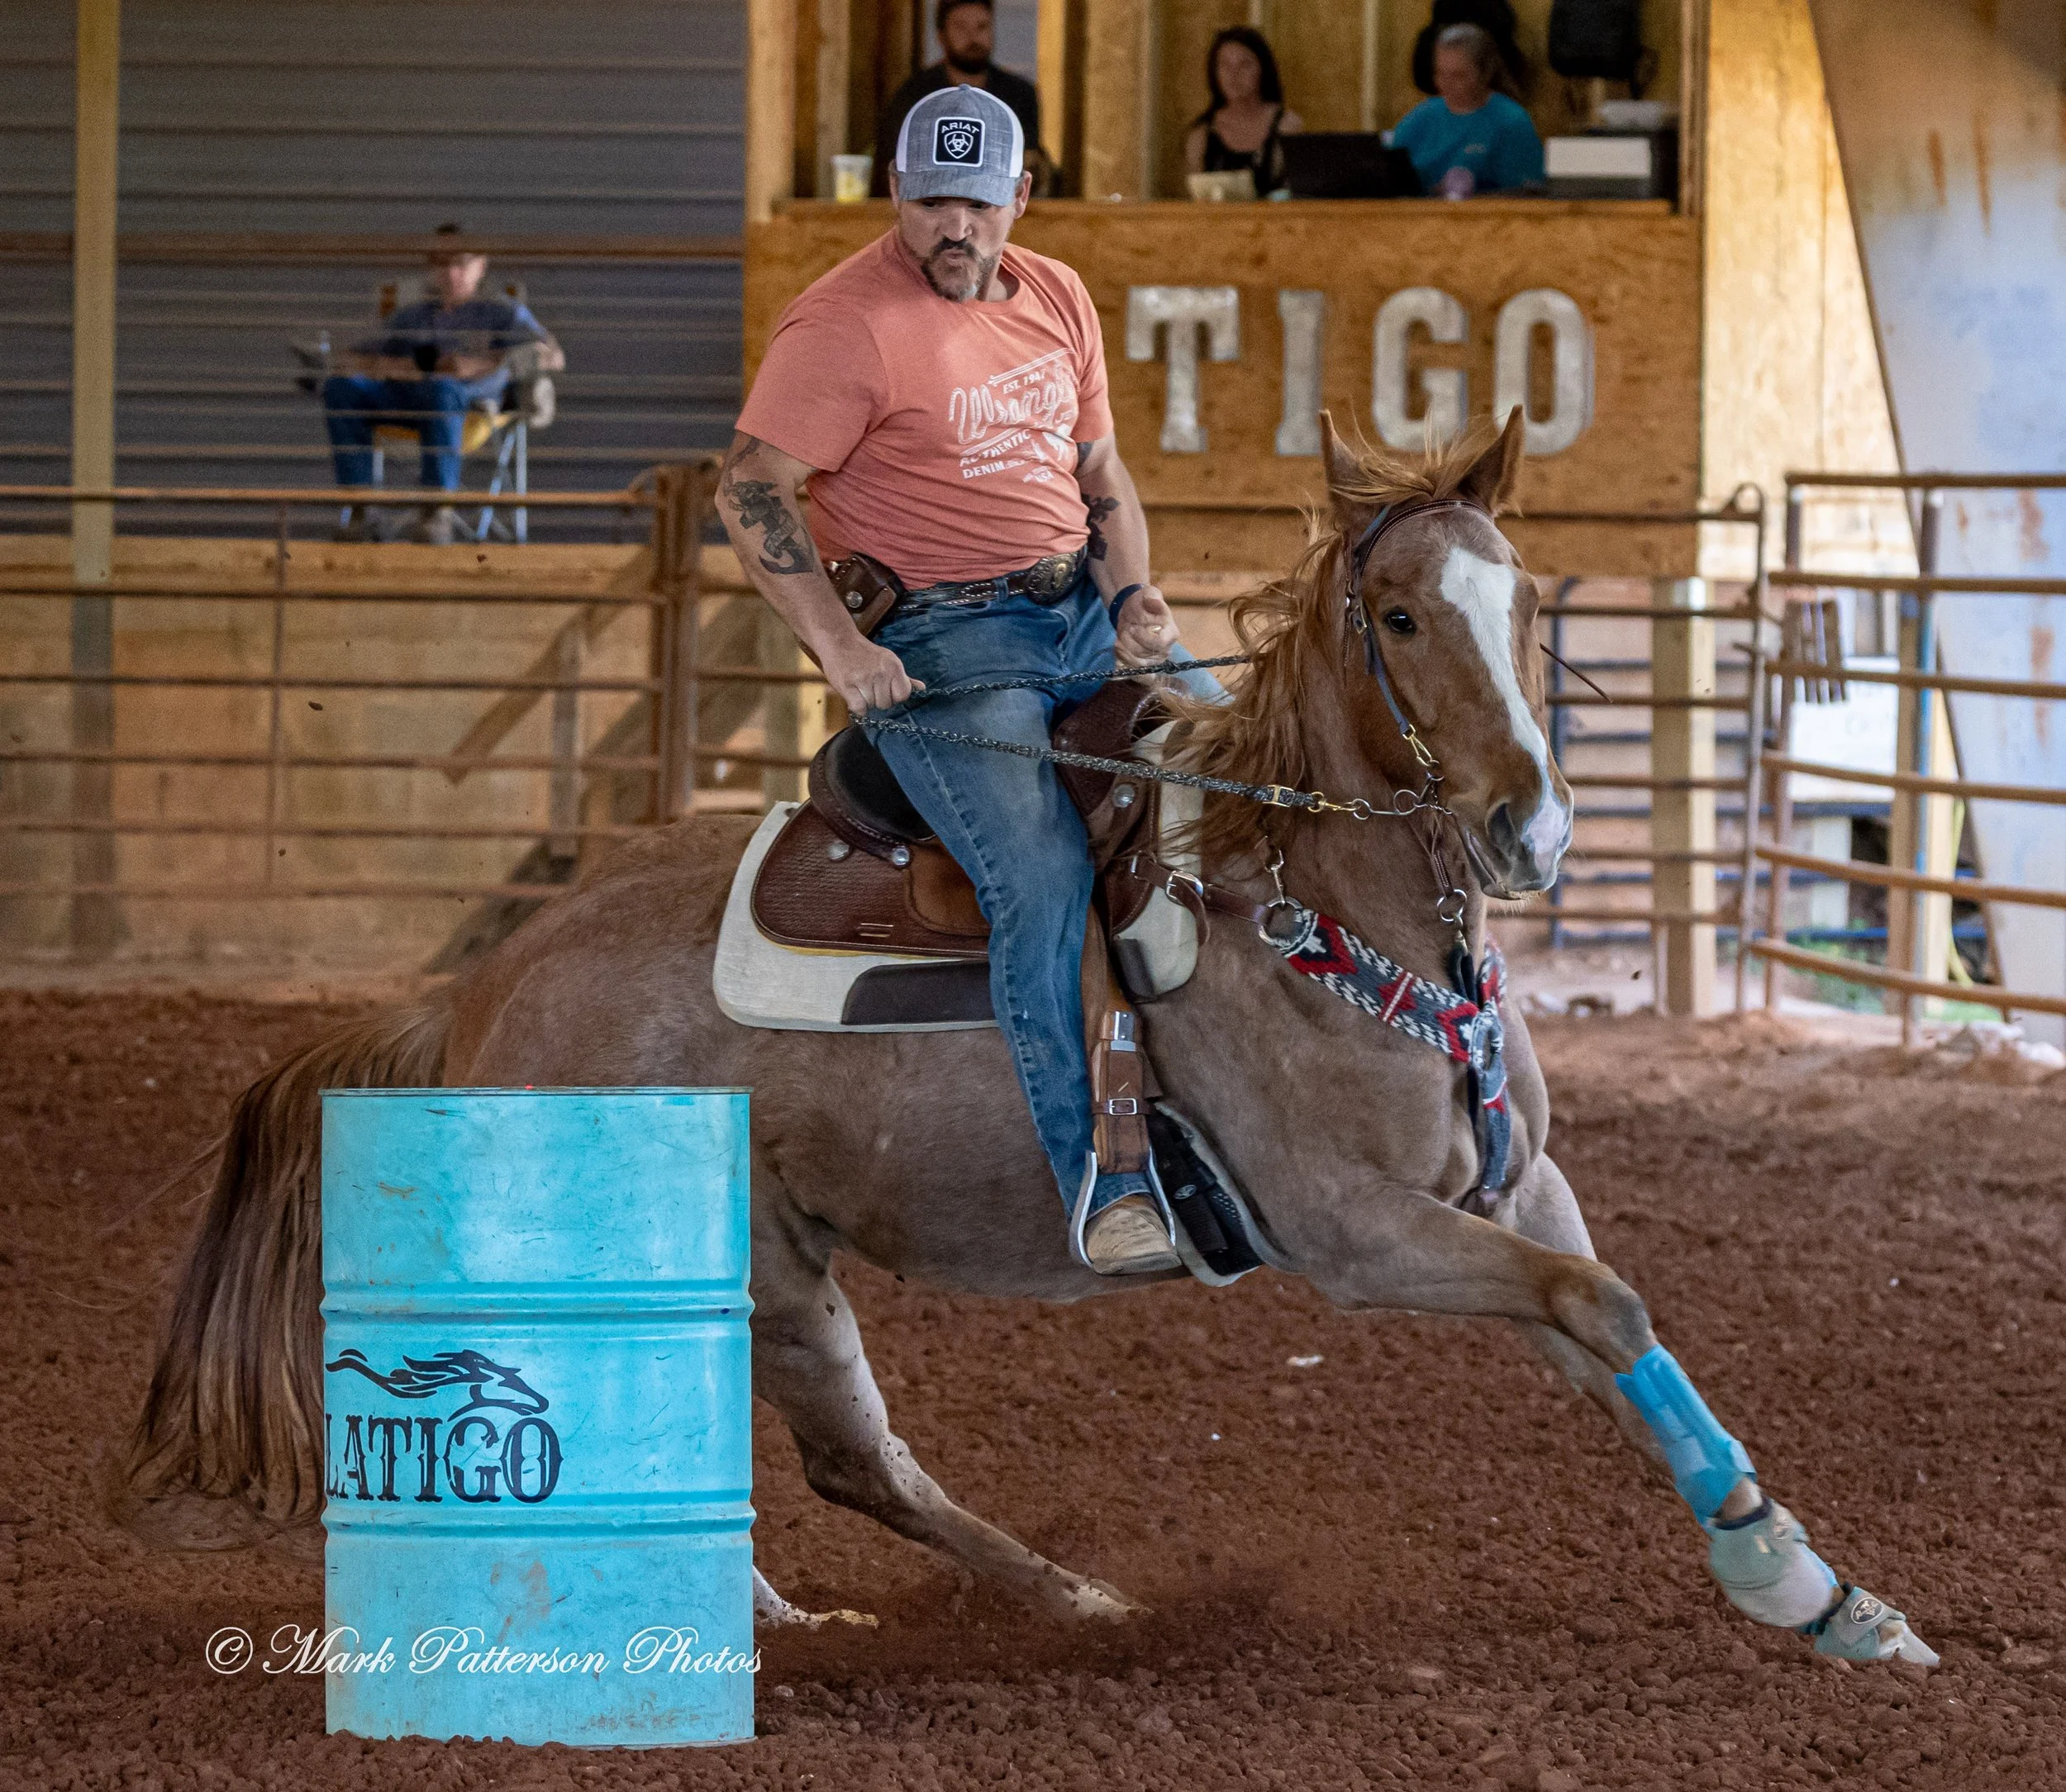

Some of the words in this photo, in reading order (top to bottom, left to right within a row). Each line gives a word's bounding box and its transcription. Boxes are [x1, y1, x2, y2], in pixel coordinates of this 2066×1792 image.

[940, 121, 980, 134] ARIAT
[949, 359, 1078, 445] Wrang
[962, 460, 1006, 479] DENIM
[325, 1413, 564, 1504] LATIGO
